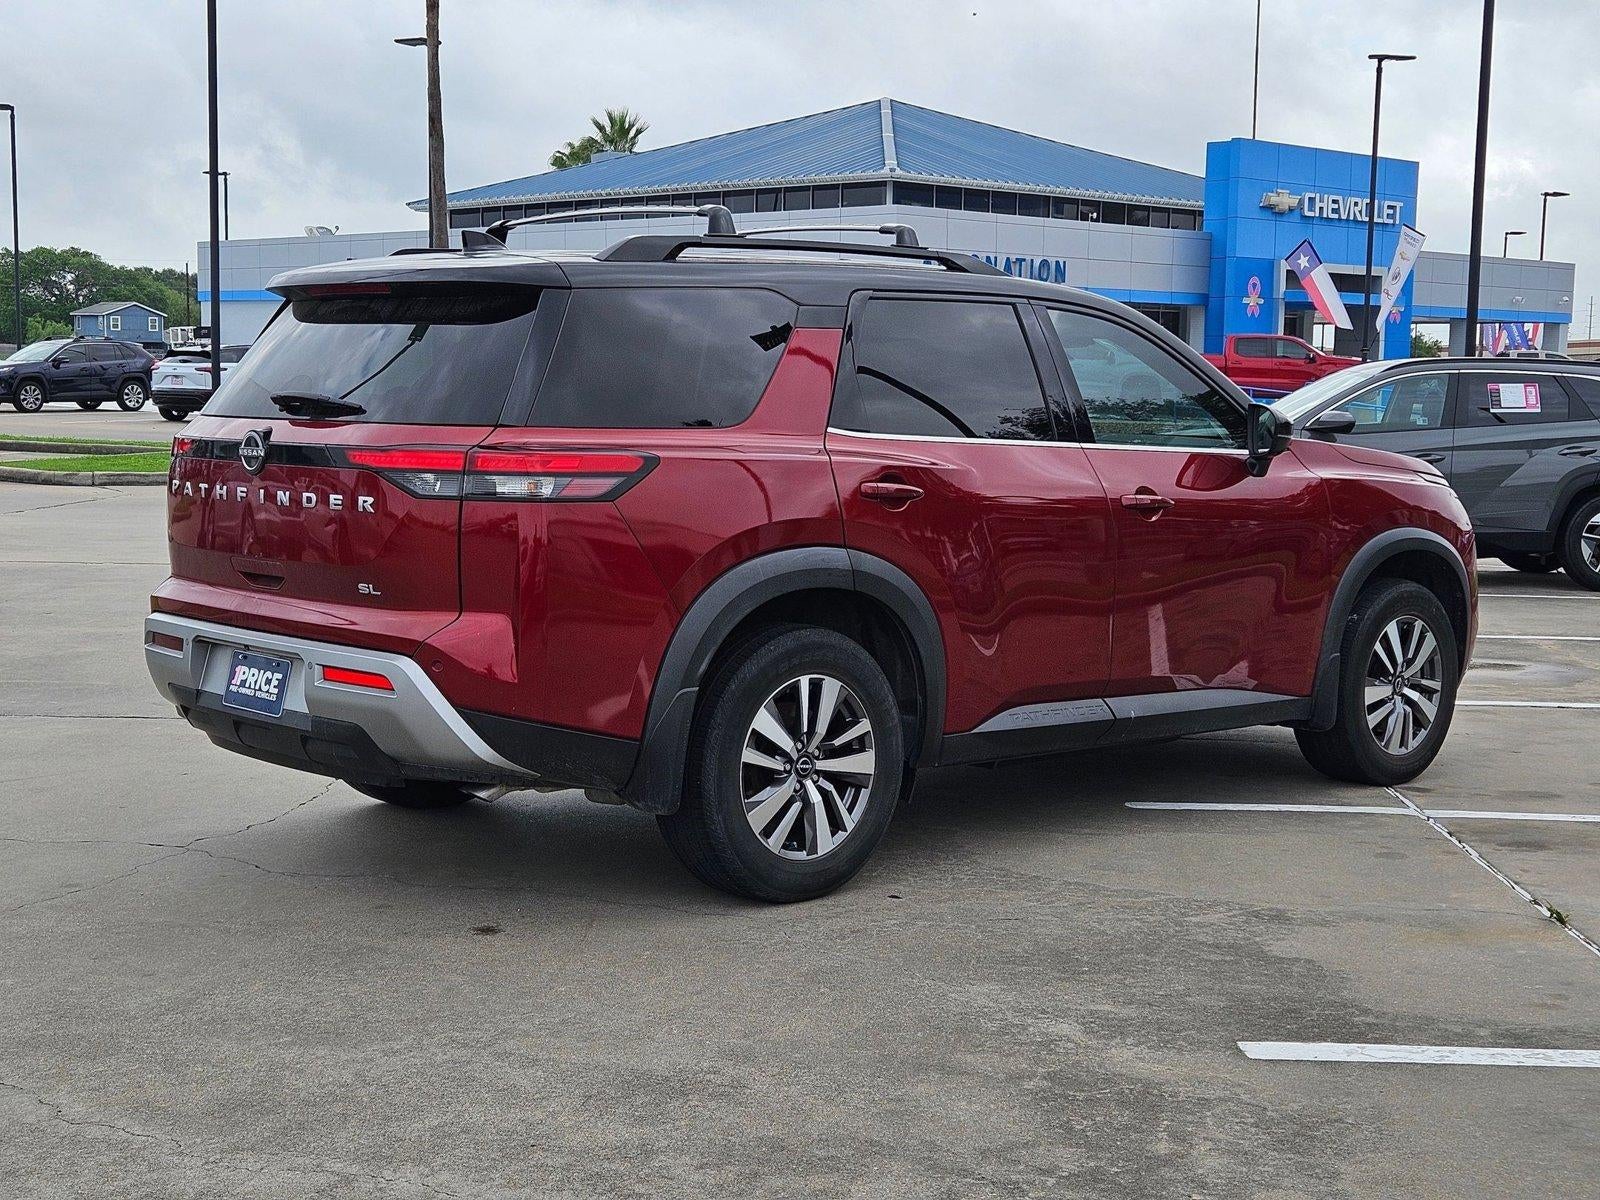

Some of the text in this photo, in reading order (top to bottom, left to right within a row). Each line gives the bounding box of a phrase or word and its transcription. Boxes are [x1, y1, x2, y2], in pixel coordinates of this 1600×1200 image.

[1304, 192, 1404, 225] CHEVROLET
[239, 447, 264, 457] NISSAN
[171, 479, 375, 513] PATHFINDER
[357, 583, 382, 595] SL
[229, 684, 277, 701] PRE-OWNED VEHICLES
